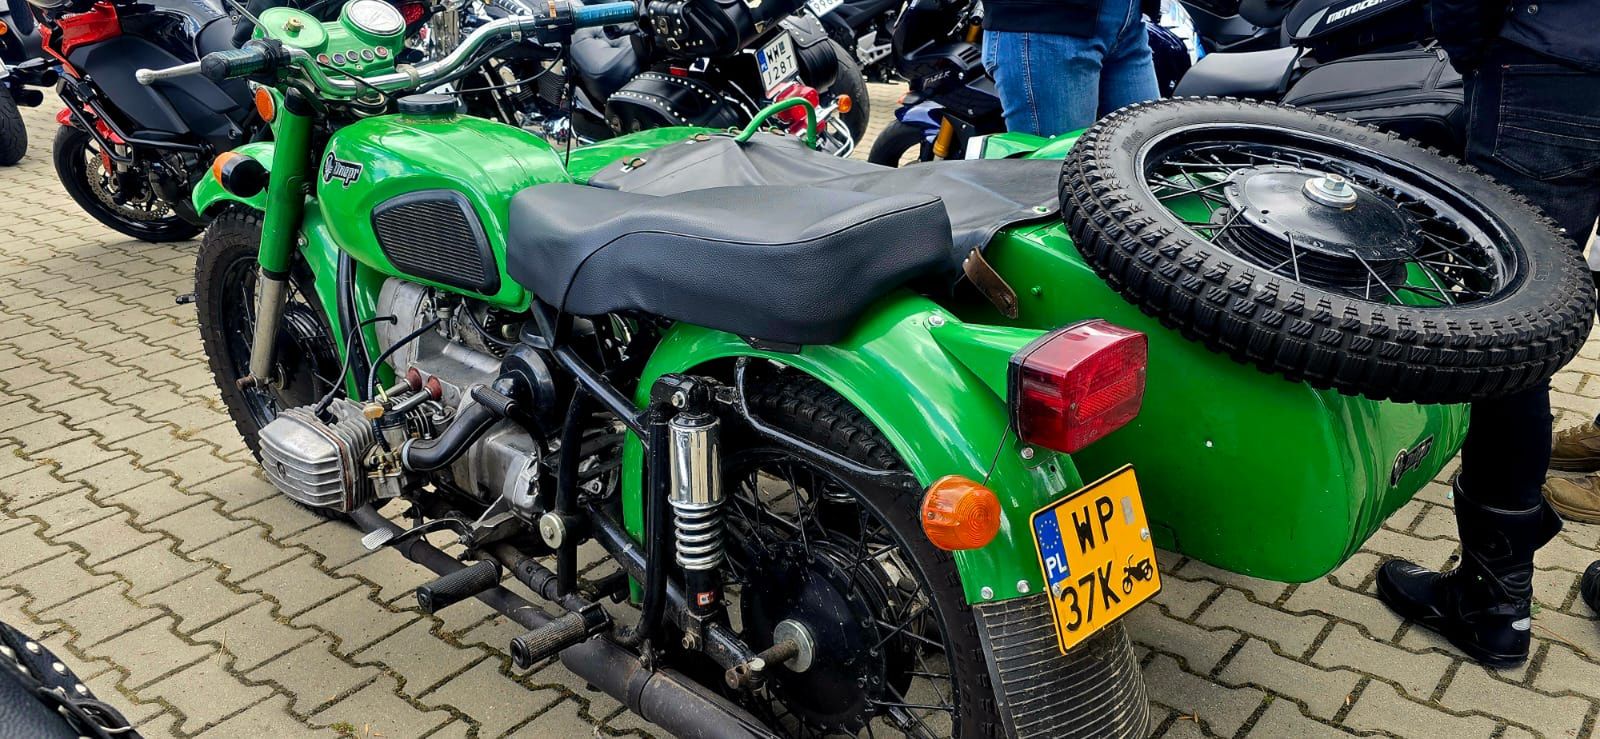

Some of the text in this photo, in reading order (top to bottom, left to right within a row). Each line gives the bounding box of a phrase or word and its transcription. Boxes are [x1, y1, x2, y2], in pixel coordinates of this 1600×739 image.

[767, 55, 793, 86] J28T
[1072, 496, 1114, 554] WP
[1045, 553, 1068, 579] PL
[1060, 560, 1121, 632] 37K
